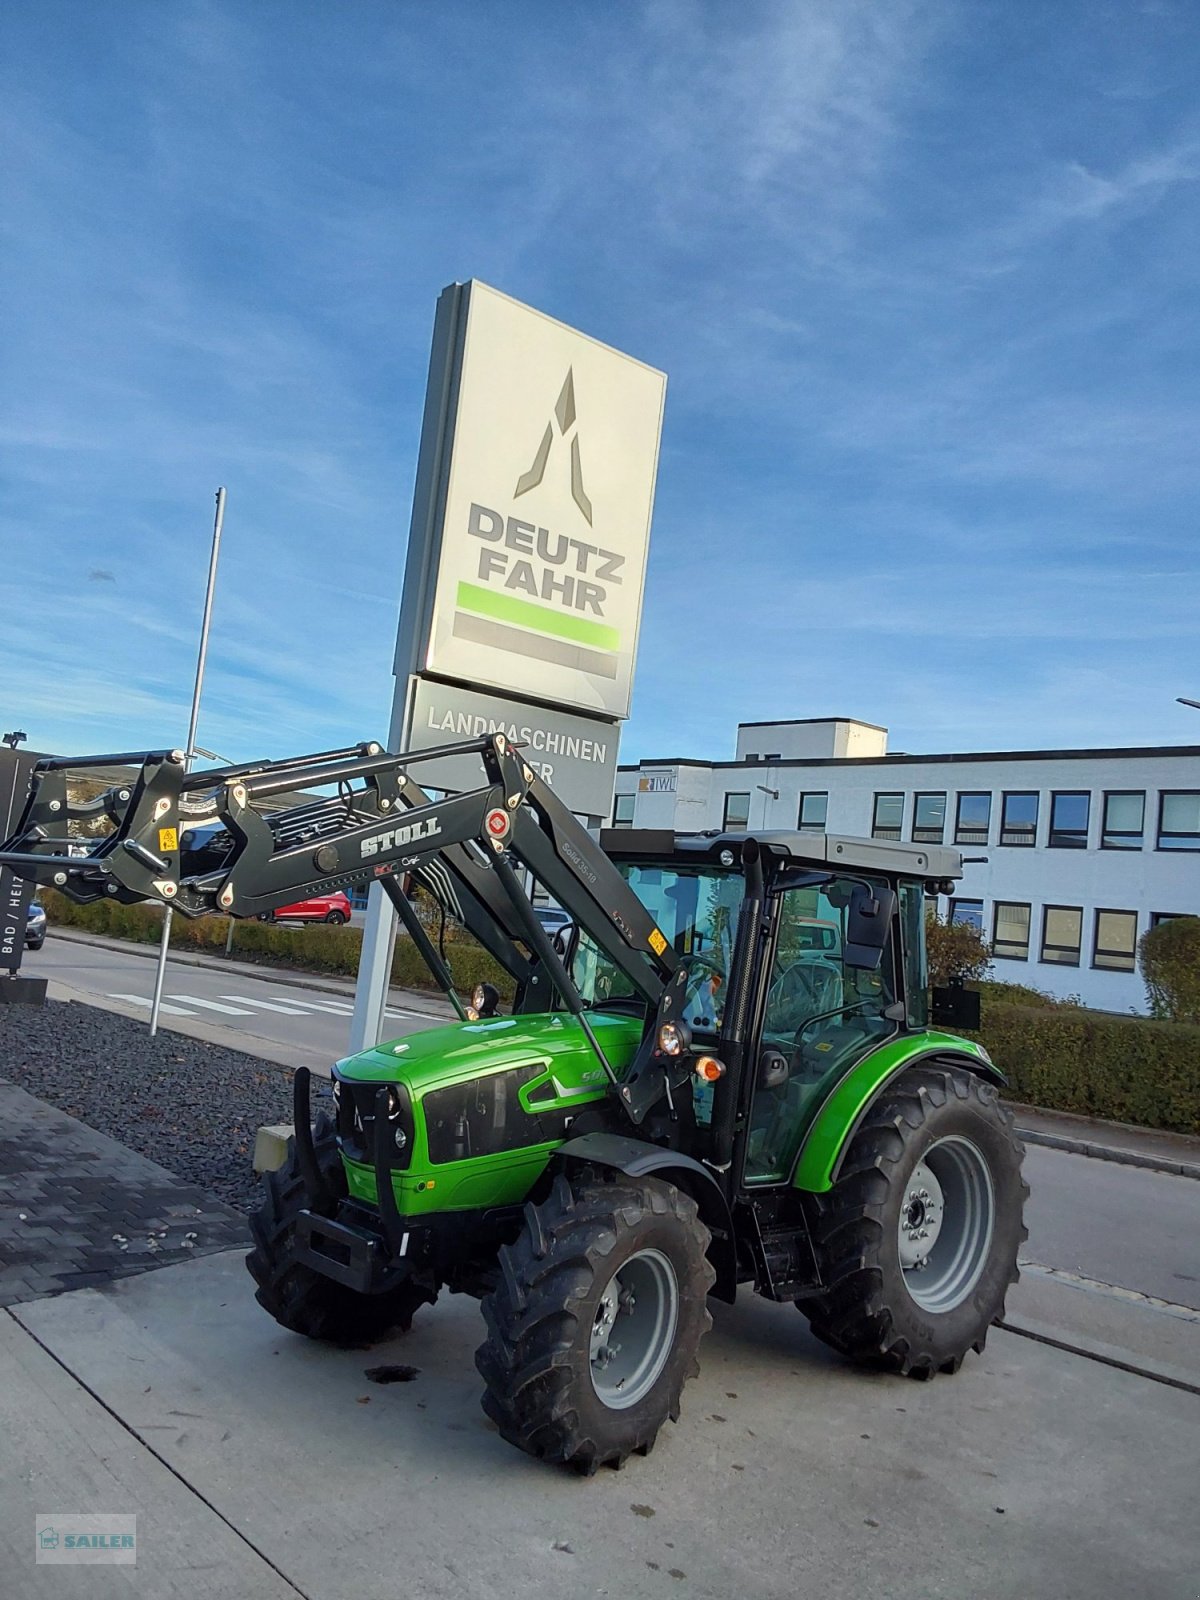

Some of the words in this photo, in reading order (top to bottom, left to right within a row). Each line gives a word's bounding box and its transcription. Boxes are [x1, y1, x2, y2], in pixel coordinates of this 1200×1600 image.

[467, 502, 626, 585] DEUTZ
[477, 546, 607, 617] FAHR
[361, 817, 442, 859] STOLL
[562, 842, 581, 863] Solid
[1, 926, 16, 954] BAD
